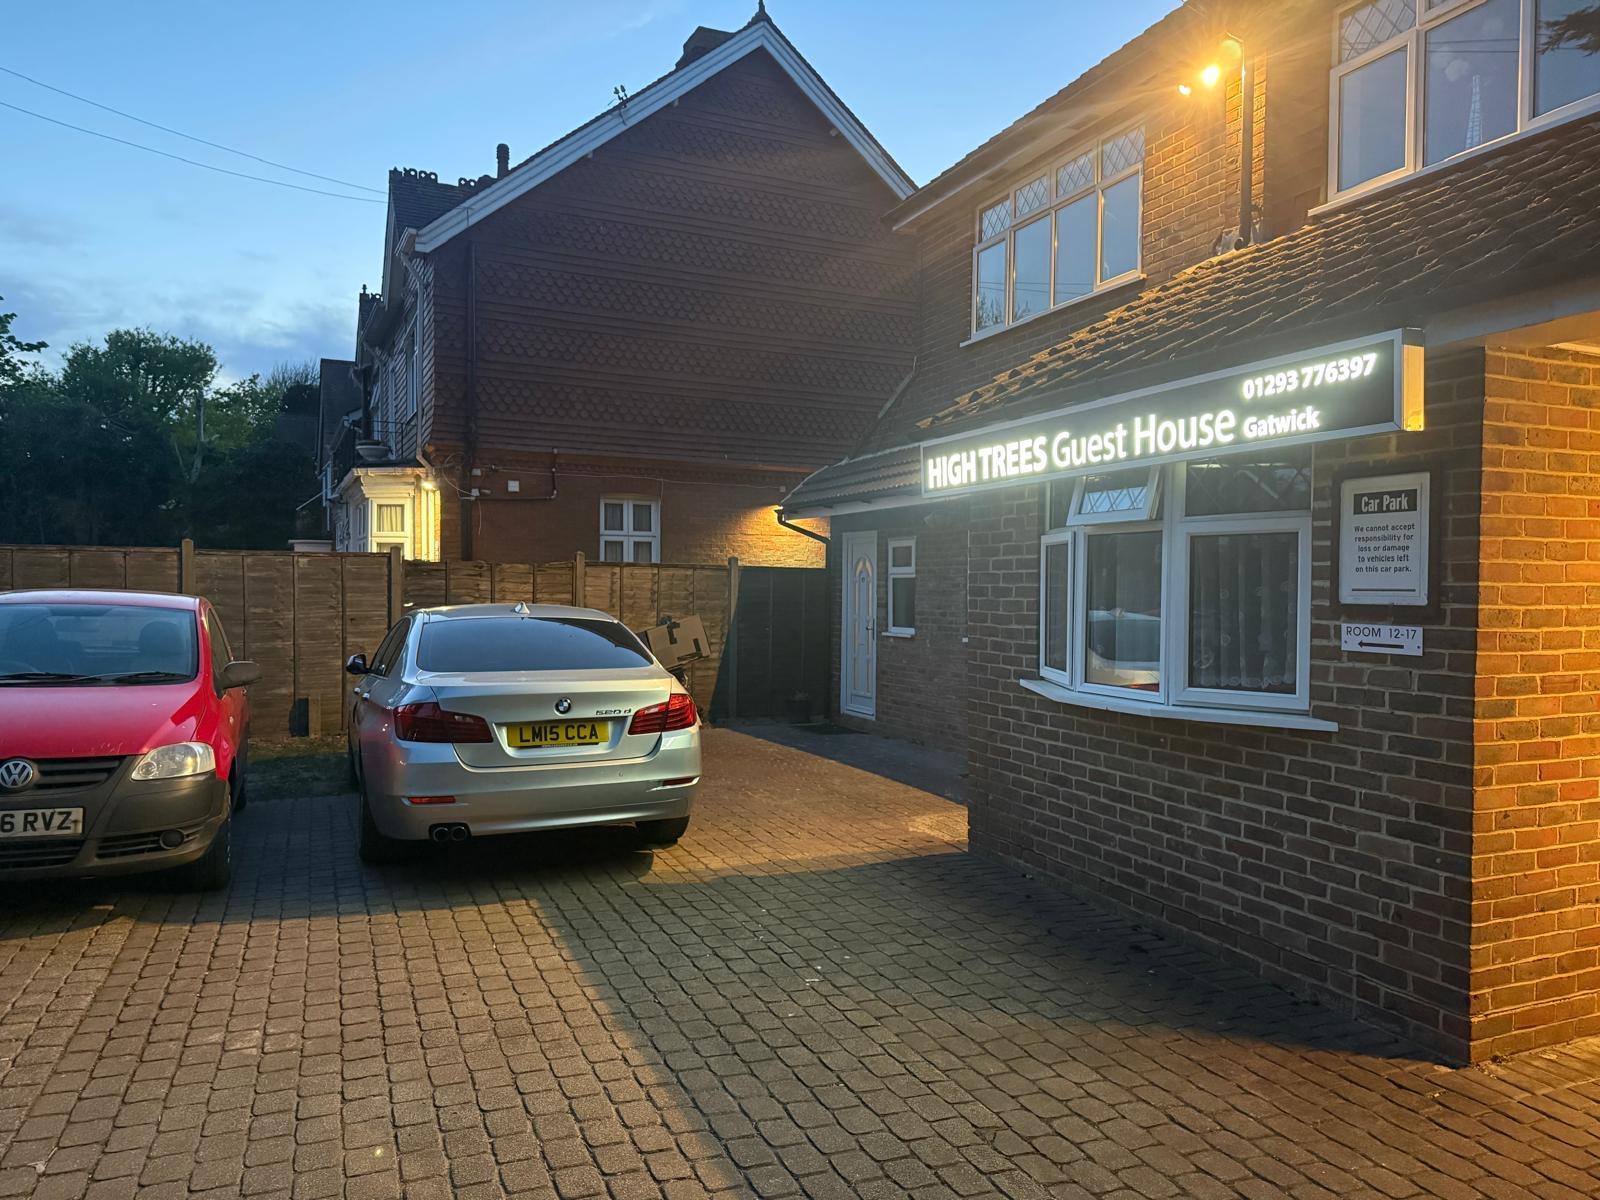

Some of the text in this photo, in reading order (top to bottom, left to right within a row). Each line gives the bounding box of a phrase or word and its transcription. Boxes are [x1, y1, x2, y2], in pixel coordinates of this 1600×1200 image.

[1242, 353, 1378, 400] 01293 776397
[926, 405, 1321, 490] HIGH TREES Guest House Gatwick
[1361, 492, 1409, 513] Car Park
[1354, 523, 1415, 533] We cannot accept
[1354, 533, 1414, 543] responsibility for
[1382, 544, 1410, 553] damage
[1367, 555, 1395, 563] vehicles
[1396, 554, 1409, 562] left
[1365, 565, 1379, 573] this
[1380, 565, 1392, 573] car
[1393, 565, 1412, 574] park.
[1346, 625, 1417, 640] ROOM 12-17
[519, 723, 599, 744] LM15 CCA
[22, 811, 73, 833] RVZ
